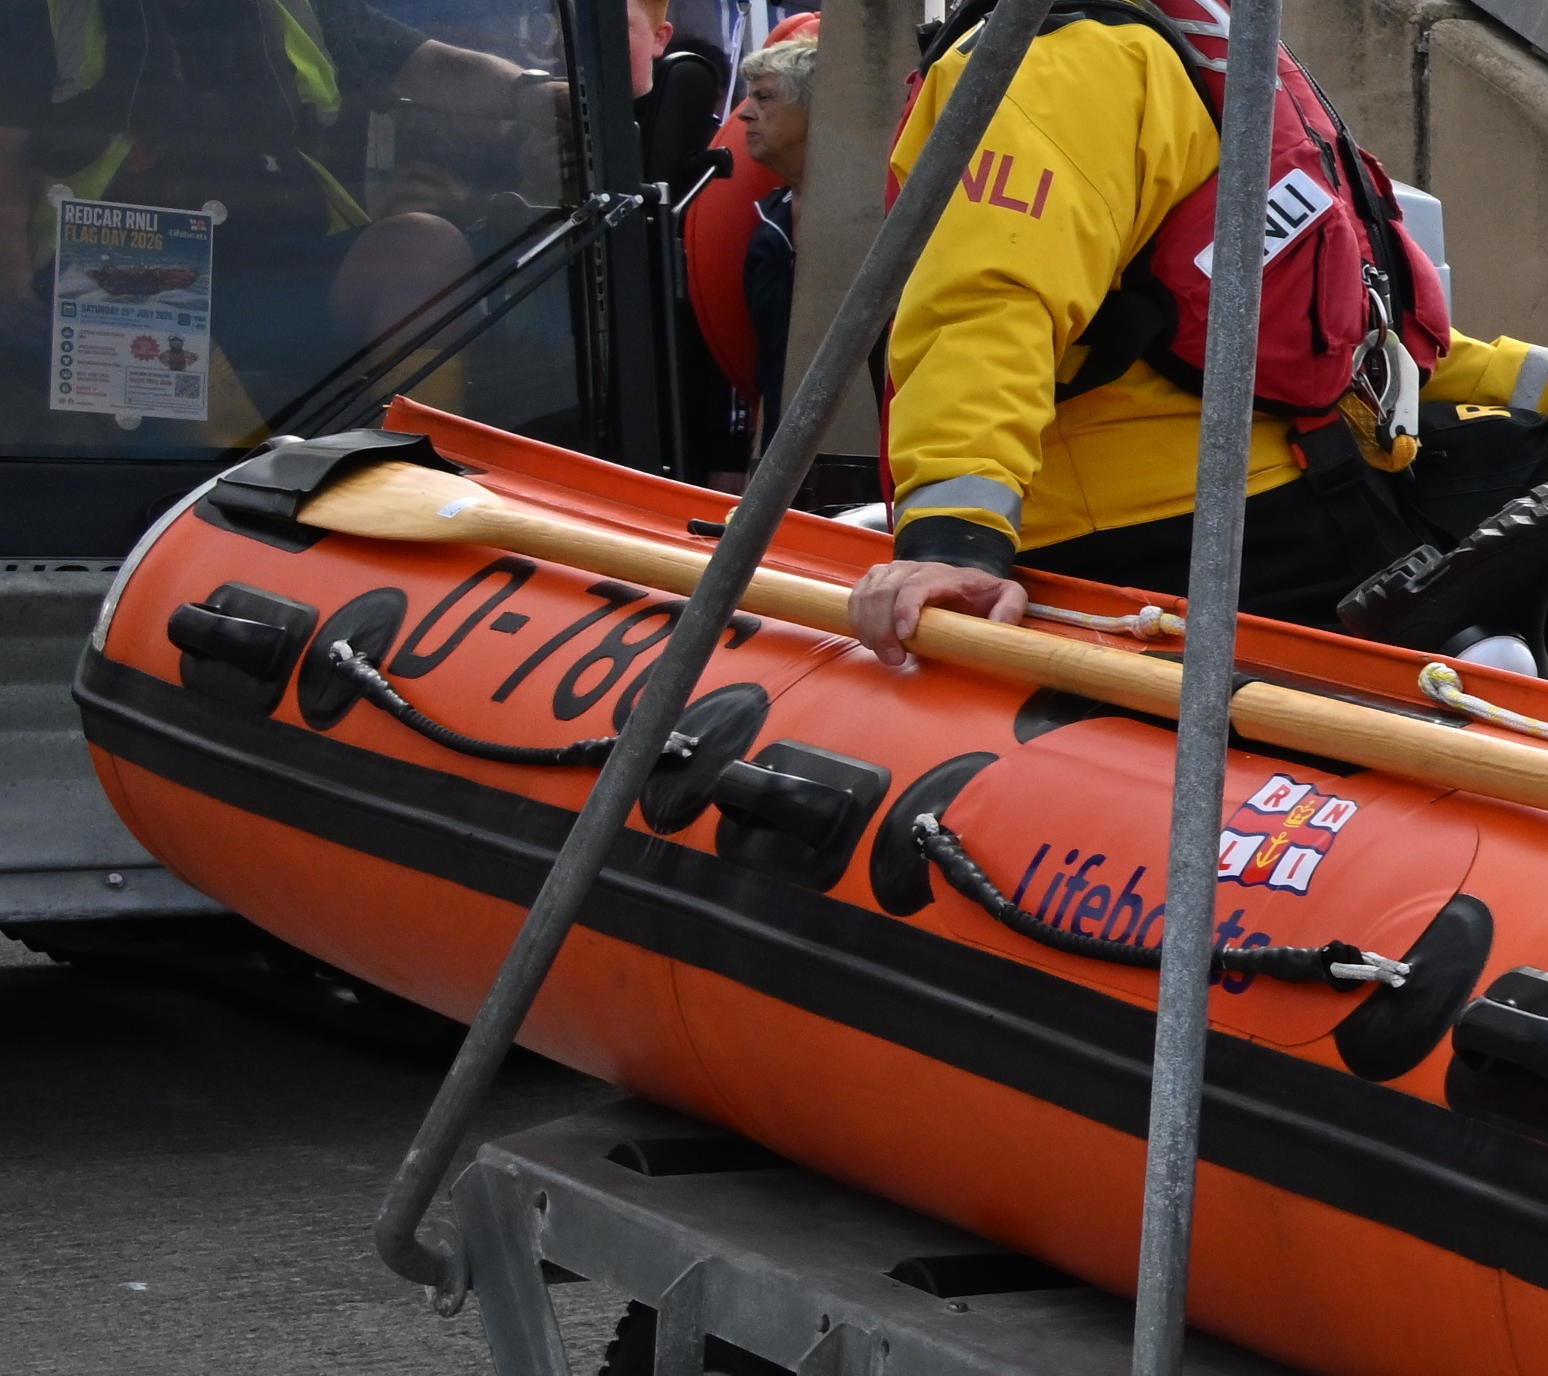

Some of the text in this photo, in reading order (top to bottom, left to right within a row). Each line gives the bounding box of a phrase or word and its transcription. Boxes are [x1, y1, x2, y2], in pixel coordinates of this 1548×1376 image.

[962, 149, 1054, 220] NLI
[65, 205, 158, 232] REDCAR RNLI
[1264, 183, 1316, 256] NLI
[64, 224, 163, 250] FLAG DAY 2026
[81, 304, 120, 315] SATURDAY
[1263, 784, 1349, 823] R N
